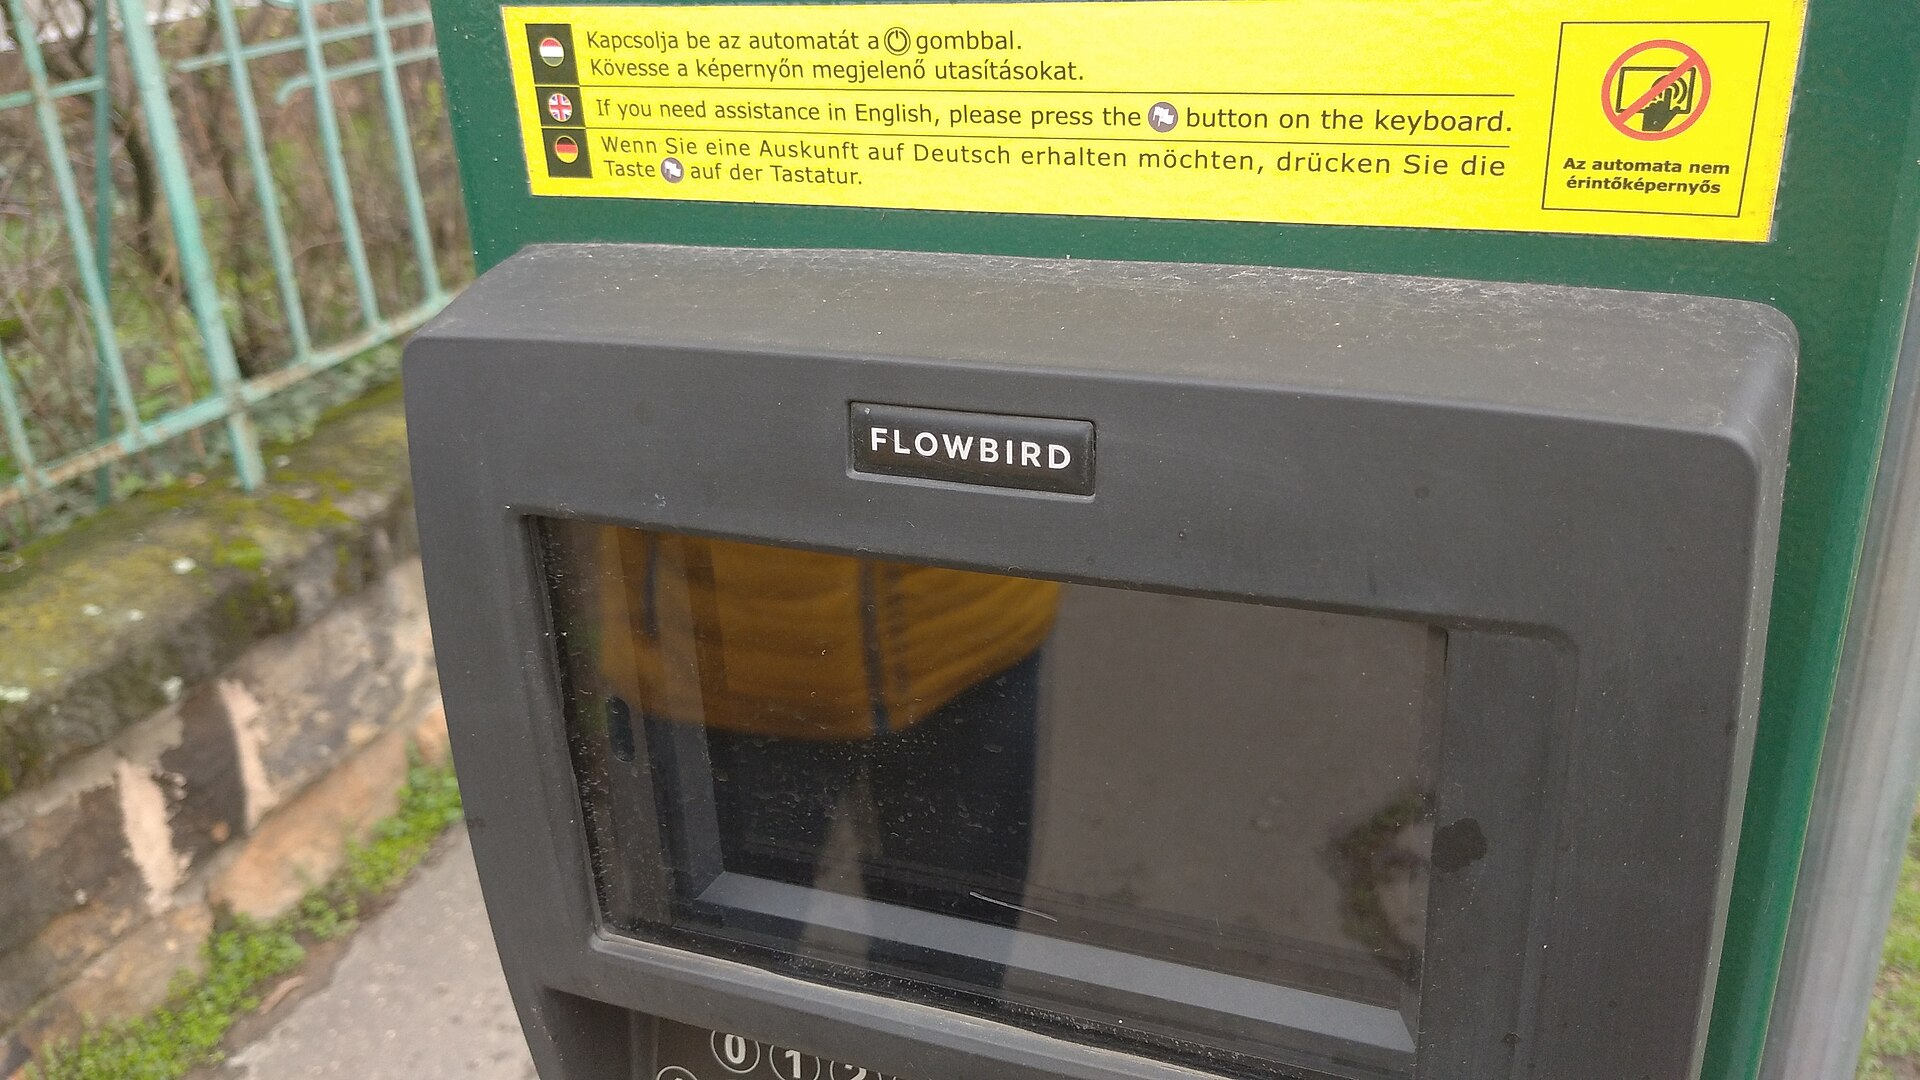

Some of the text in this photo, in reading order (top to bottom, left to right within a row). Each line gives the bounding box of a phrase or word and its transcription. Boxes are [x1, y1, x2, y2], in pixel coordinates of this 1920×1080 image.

[586, 29, 1022, 55] Kapcsolja be az automatát a gombbal.
[590, 57, 1084, 84] Kövesse a képernyőn megjelenő utasításokat.
[595, 98, 1512, 136] If you need assistance in English, please press the button on the keyboard.
[600, 136, 1505, 177] Wenn Sie eine Auskunft auf Deutsch erhalten möchten, drücken Sie die
[1562, 157, 1730, 175] Az automata nem
[603, 159, 862, 185] Taste auf der Tastatur.
[1566, 172, 1723, 196] érintőképernyős
[870, 426, 1072, 471] FLOWBIRD
[785, 1049, 801, 1079] 1
